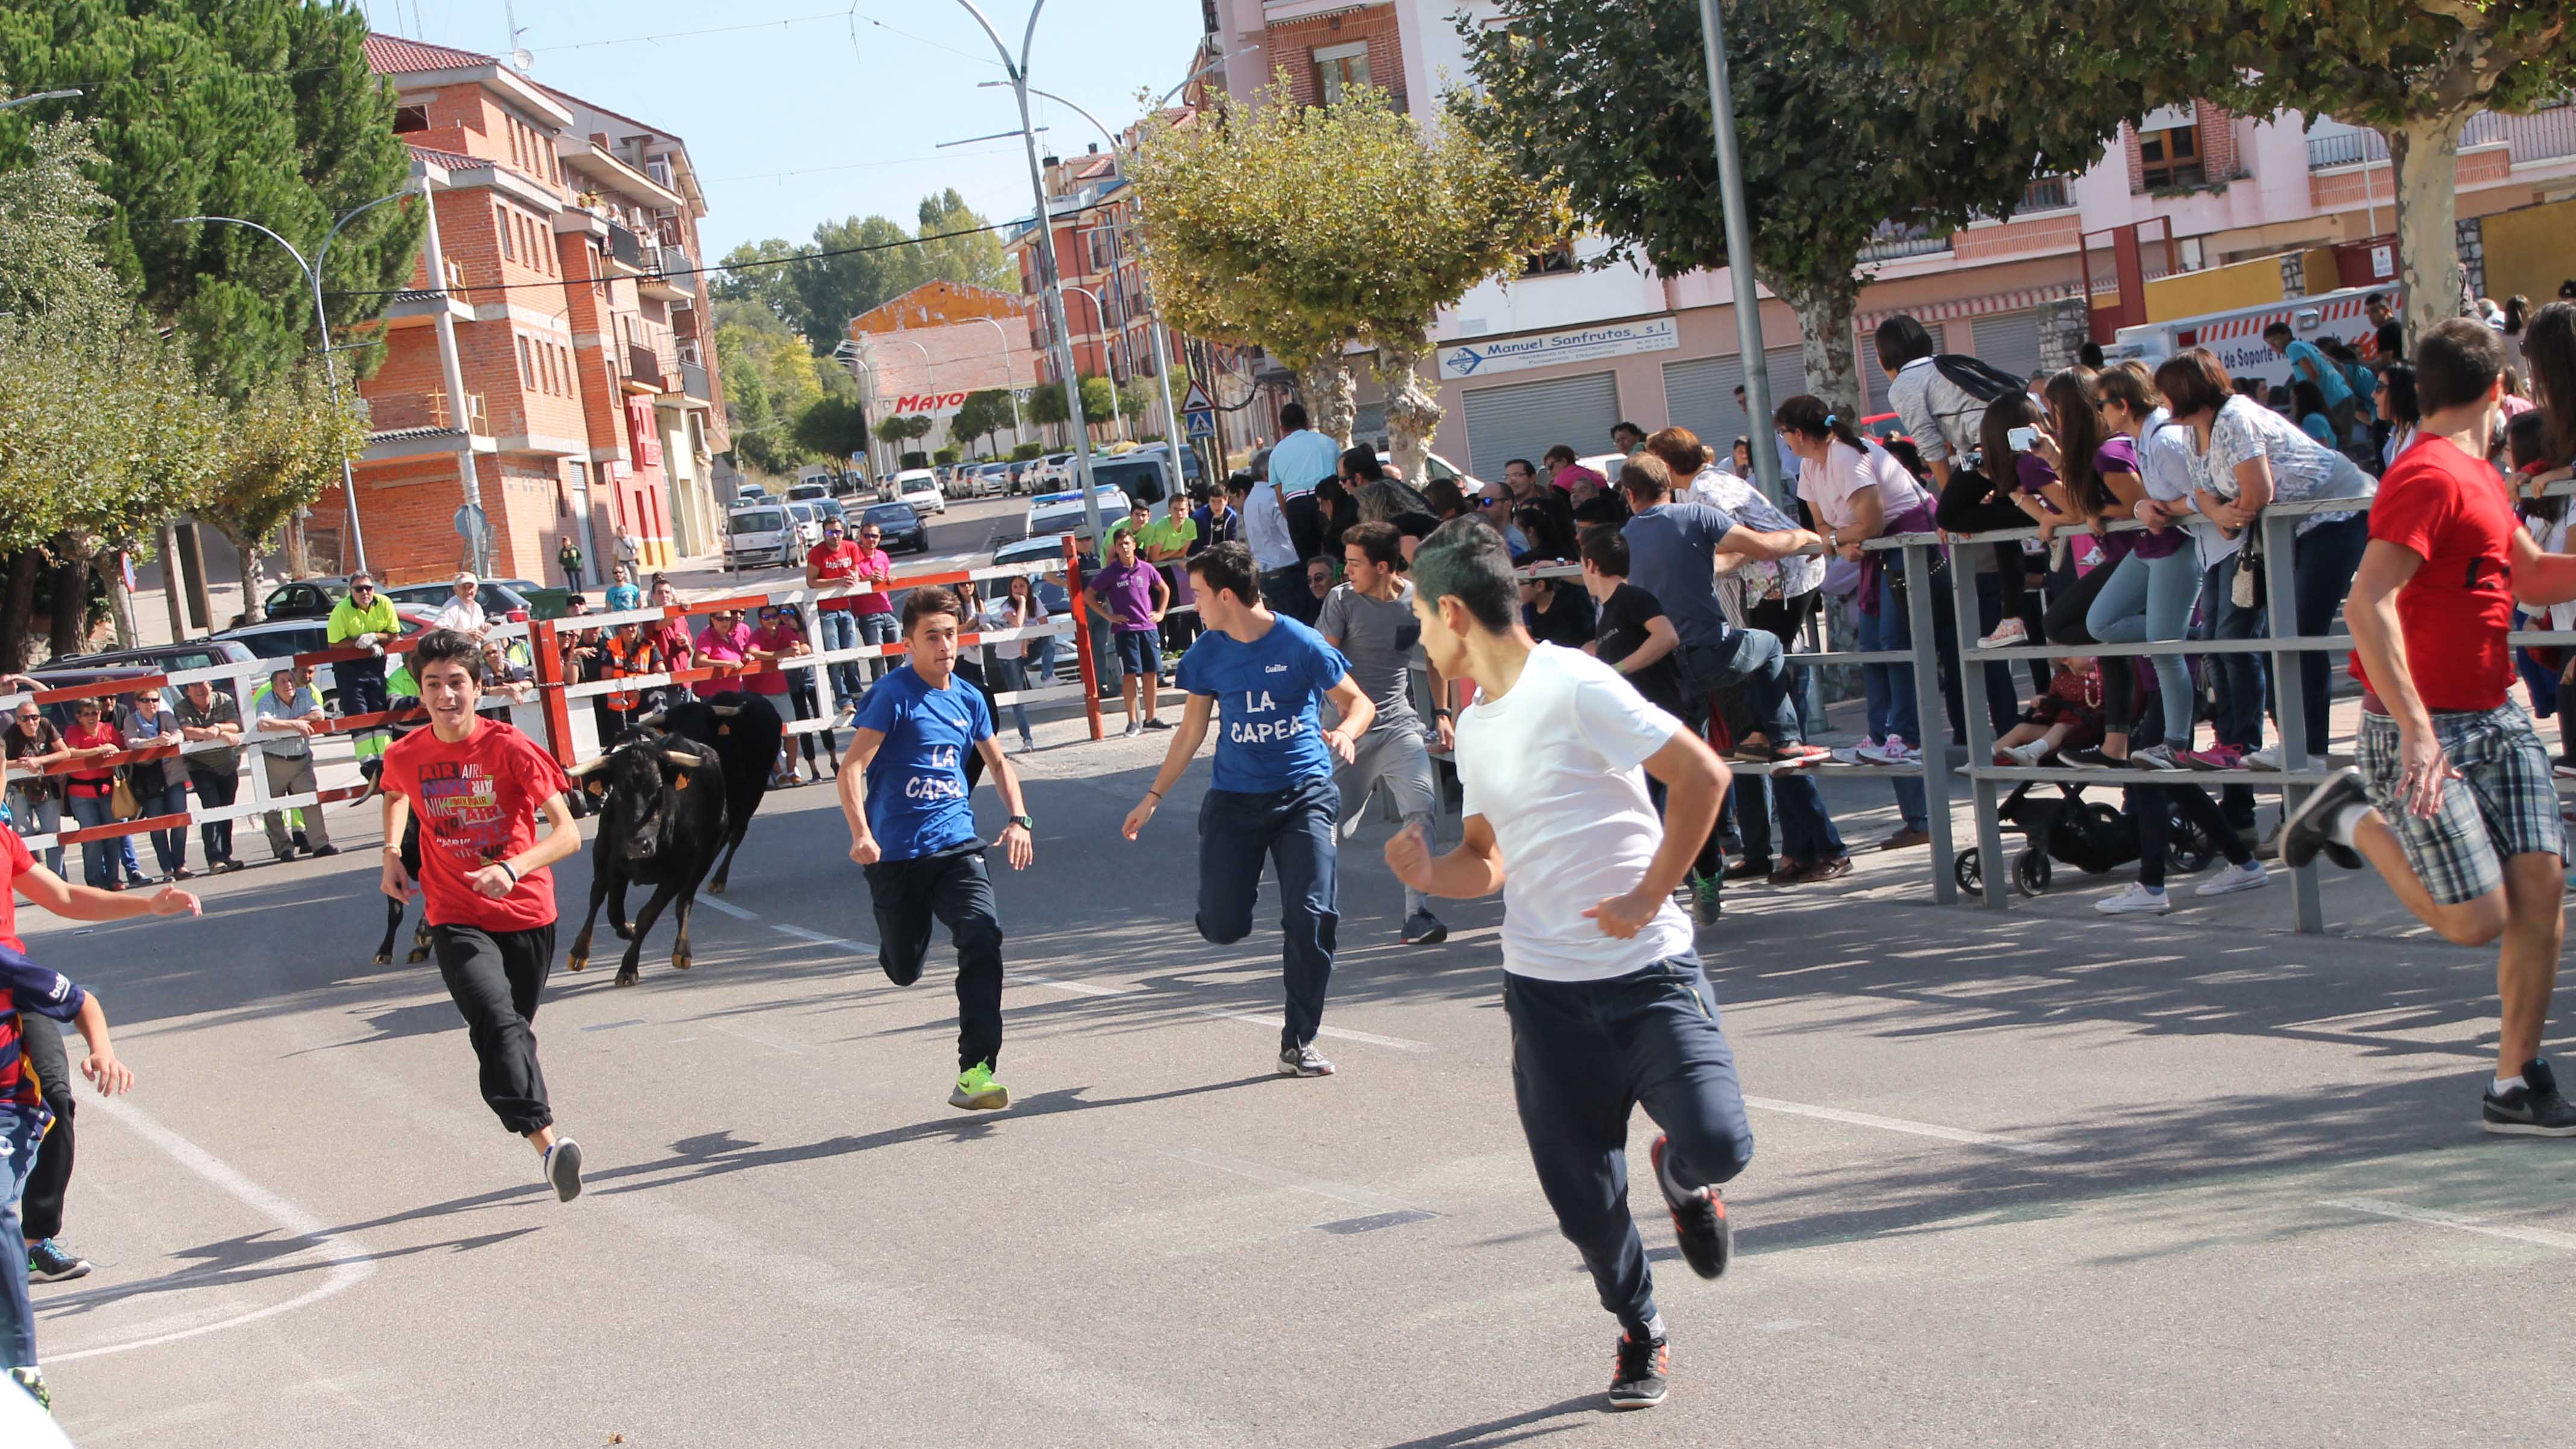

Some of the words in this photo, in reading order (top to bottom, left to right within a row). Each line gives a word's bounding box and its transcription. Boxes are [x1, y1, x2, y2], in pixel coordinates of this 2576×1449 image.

[1488, 338, 1542, 355] Manuel
[1552, 329, 1636, 346] Sanfrutos,
[1646, 321, 1671, 334] s.l.
[2224, 350, 2236, 369] de
[2237, 345, 2273, 370] Soporte
[895, 392, 974, 414] MAYO
[1246, 690, 1276, 713] LA
[1231, 715, 1302, 743] CAPEA
[932, 745, 955, 767] LA
[421, 763, 455, 781] AIR
[461, 763, 483, 779] AIR!
